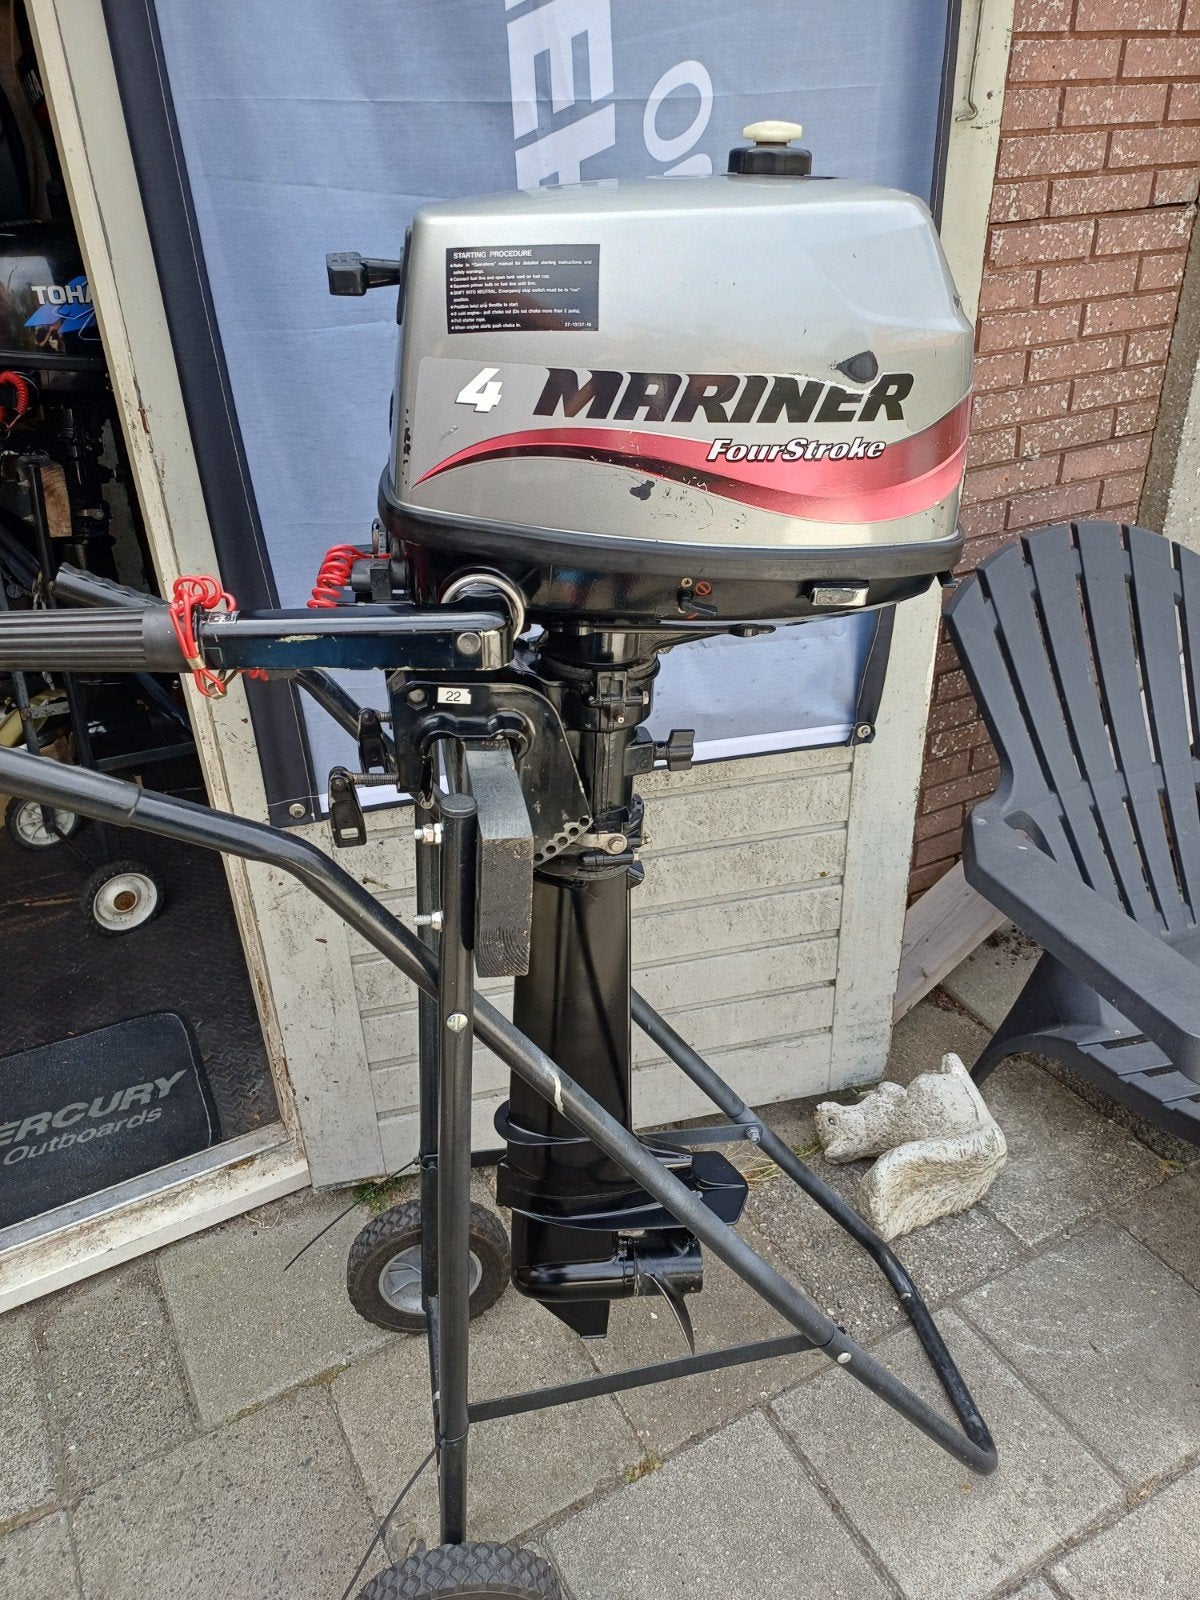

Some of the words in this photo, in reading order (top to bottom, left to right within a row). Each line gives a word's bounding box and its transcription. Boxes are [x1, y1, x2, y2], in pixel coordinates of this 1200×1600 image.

[455, 367, 503, 413] 4
[532, 368, 915, 424] MARINER
[706, 437, 888, 464] FourStroke
[446, 690, 462, 702] 22
[3, 1107, 163, 1166] Outboards
